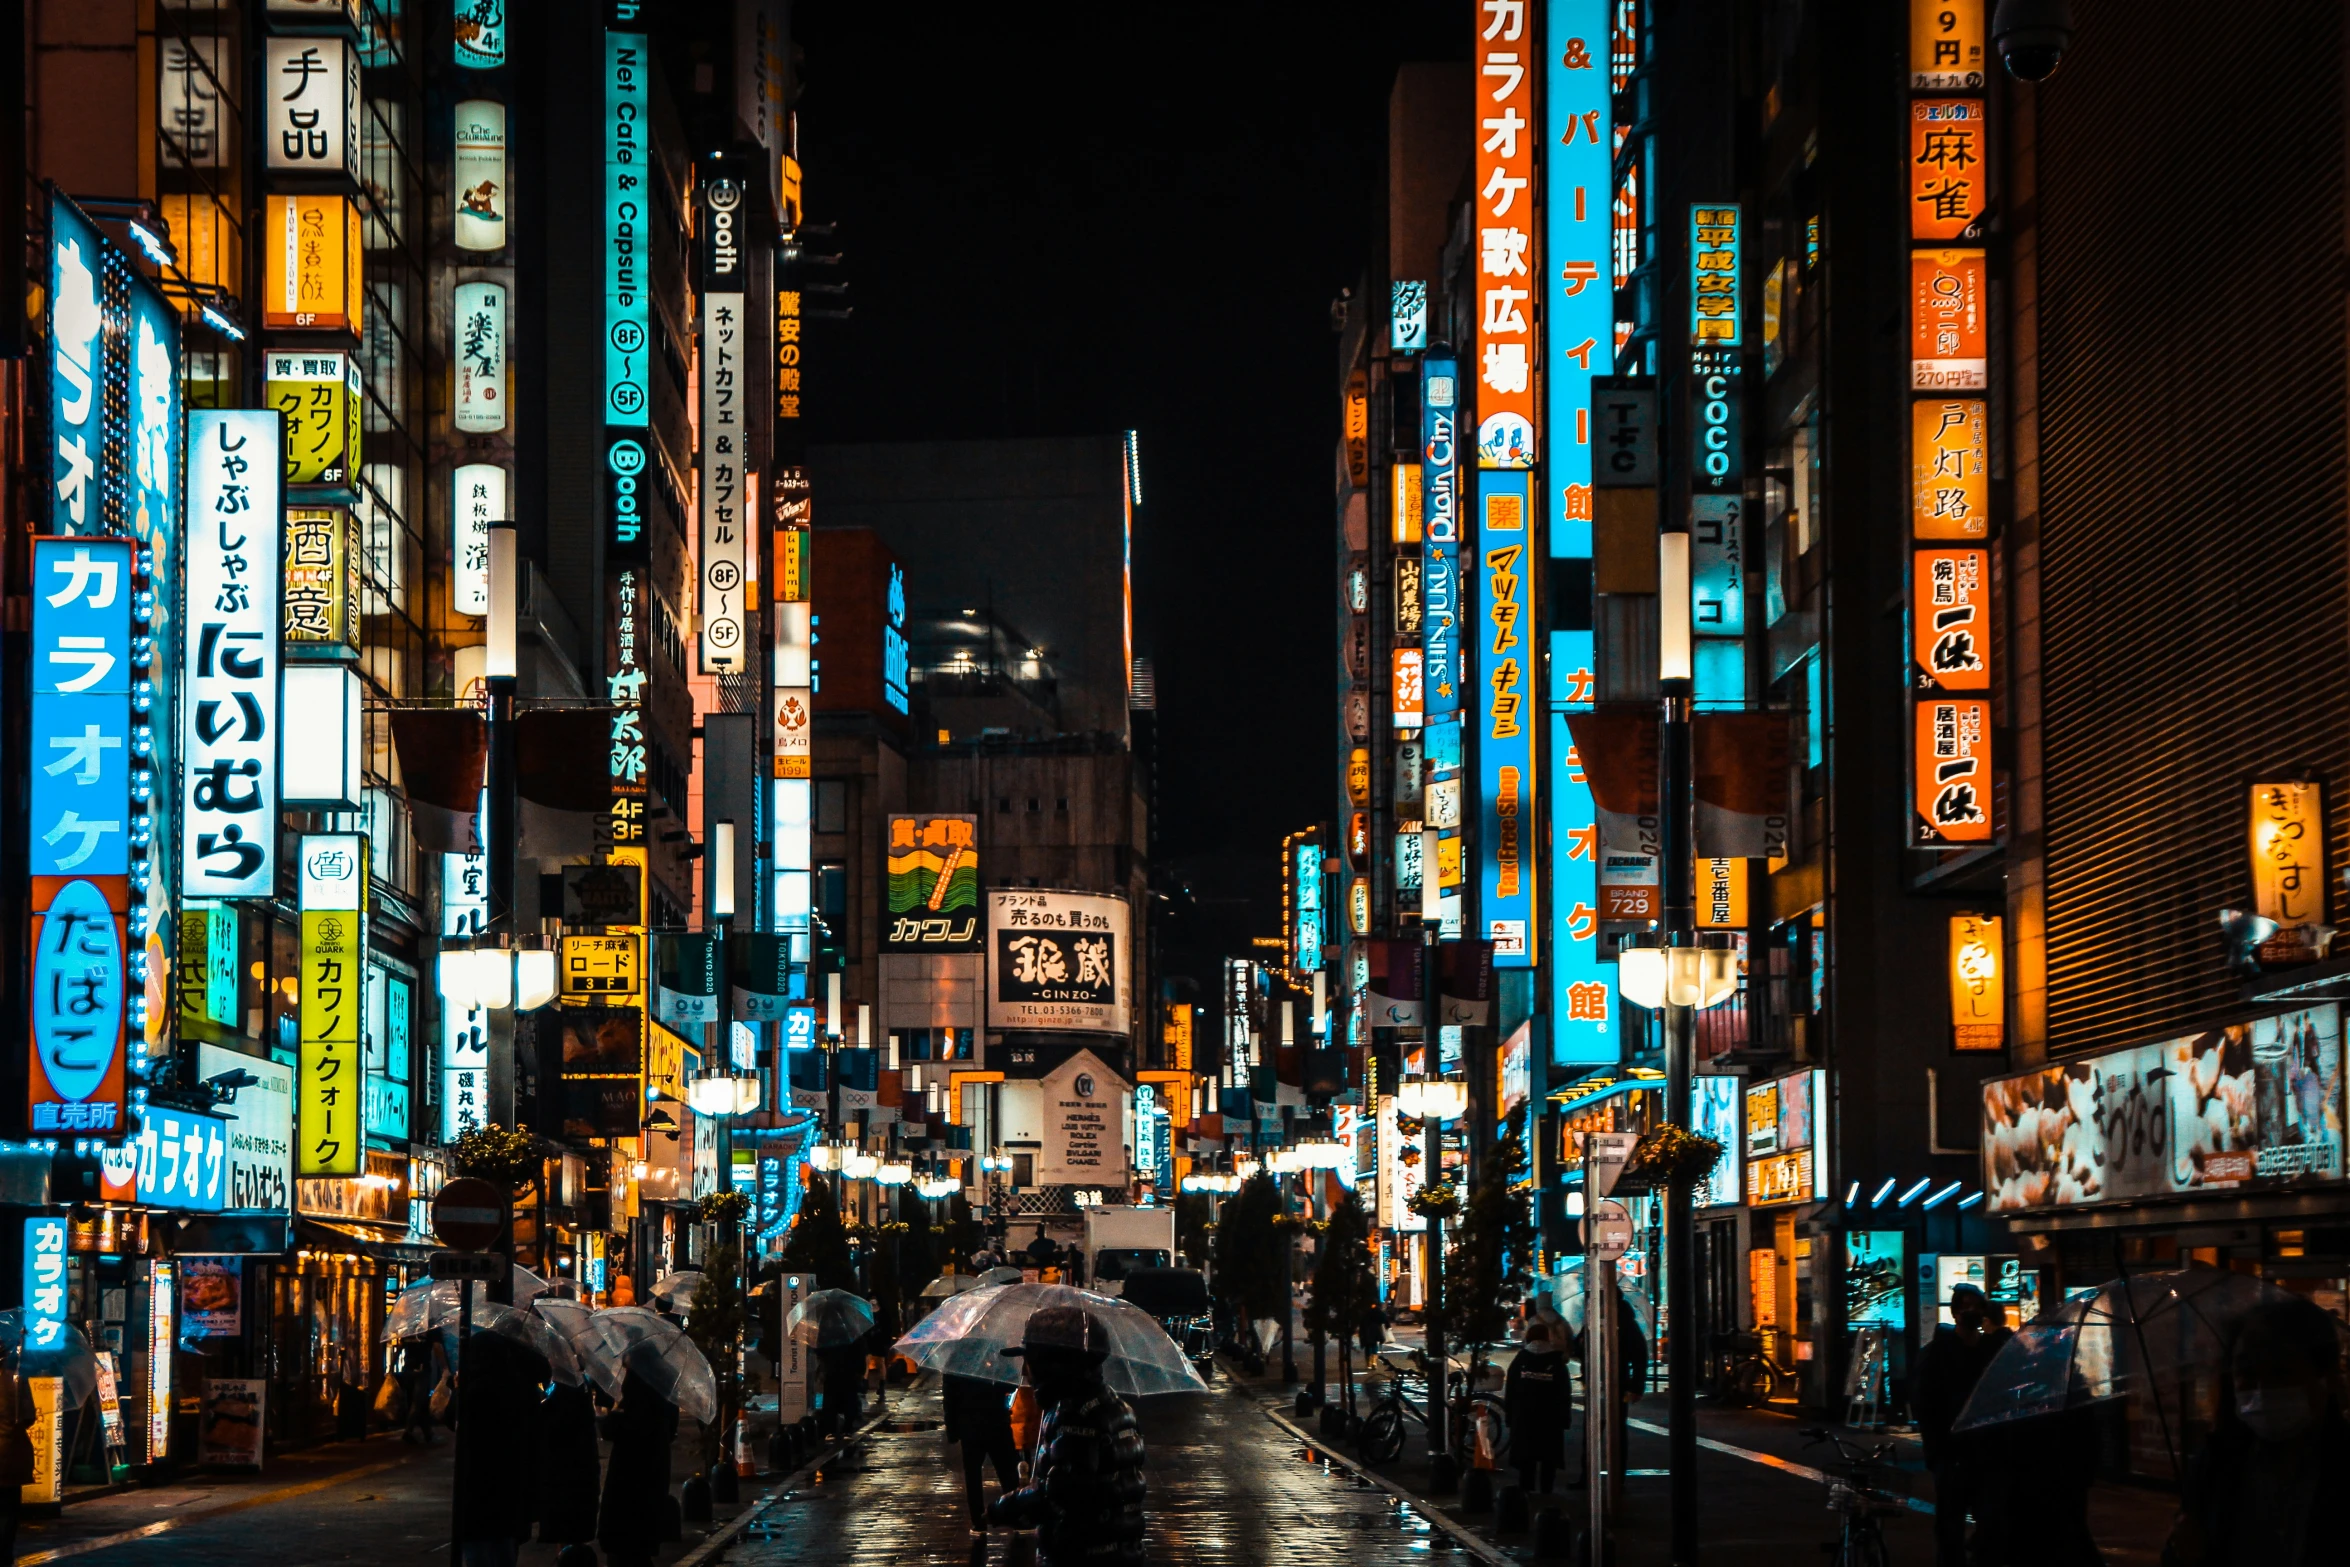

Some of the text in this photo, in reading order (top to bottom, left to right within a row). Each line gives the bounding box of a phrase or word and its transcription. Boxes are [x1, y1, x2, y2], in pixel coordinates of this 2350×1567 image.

[281, 47, 328, 160] 手品
[1914, 103, 1984, 121] ウェルカム
[614, 48, 638, 308] Net Cafe & Capsule
[1916, 125, 1978, 221] 麻雀
[1481, 0, 1529, 394] カラオケ歌広場
[708, 179, 741, 275] Booth
[1965, 224, 1985, 238] 6F
[1942, 250, 1956, 263] 5F
[295, 314, 316, 327] 6F
[1399, 283, 1421, 343] ダーツ
[275, 358, 338, 377] 質・買取
[779, 290, 800, 418] 驚安の殿堂
[1692, 352, 1732, 363] Hair
[1692, 364, 1742, 376] Space
[714, 306, 735, 545] ネットカフェ & カプセル
[1705, 375, 1730, 476] COCO
[324, 469, 343, 482] 5F
[1933, 404, 1971, 519] 戸灯路
[608, 438, 646, 543] Booth
[1712, 477, 1724, 487] 4F
[214, 420, 251, 614] しゃぶしゃぶ
[1490, 499, 1521, 528] 薬
[1400, 560, 1422, 623] 山内農場
[1933, 560, 1954, 604] 焼鳥
[618, 571, 635, 666] 手作り居酒屋
[1485, 544, 1524, 739] マツモトキヨシ
[1919, 675, 1935, 688] 3F
[42, 546, 122, 872] カラオケ
[778, 738, 807, 747] 鳥メロ
[1935, 706, 1957, 757] 居酒屋
[193, 623, 266, 882] にいむら
[611, 797, 644, 819] 4F
[613, 819, 643, 841] 3F
[890, 819, 974, 848] 質・買取
[1497, 767, 1521, 898] Shop Free Tax
[1920, 826, 1938, 839] 2F
[1303, 857, 1312, 904] イタリアン
[1605, 856, 1653, 867] EXCHANGE
[997, 895, 1047, 907] ブランド品
[1610, 889, 1649, 898] BRAND
[1610, 899, 1649, 914] 729
[888, 917, 977, 943] カワノ
[1010, 908, 1110, 929] 売るのも 買うのも
[315, 946, 345, 954] QUARK
[570, 954, 631, 973] ロード
[572, 939, 630, 952] リーチ麻雀
[1007, 936, 1112, 990] 銀蔵
[705, 941, 714, 994] TOKYO 2020
[777, 942, 787, 994] TOKYO 2020
[50, 905, 110, 1071] たばこ
[788, 1011, 811, 1049] カニ
[33, 1101, 118, 1131] 直売所
[136, 1114, 225, 1201] カラオケ
[1066, 1158, 1101, 1166] CHANEL
[1068, 1141, 1098, 1149] Cartier
[231, 1160, 287, 1210] にいむら
[763, 1158, 780, 1222] カラオケ
[34, 1221, 64, 1346] カラオケ
[789, 1347, 798, 1375] Tourist
